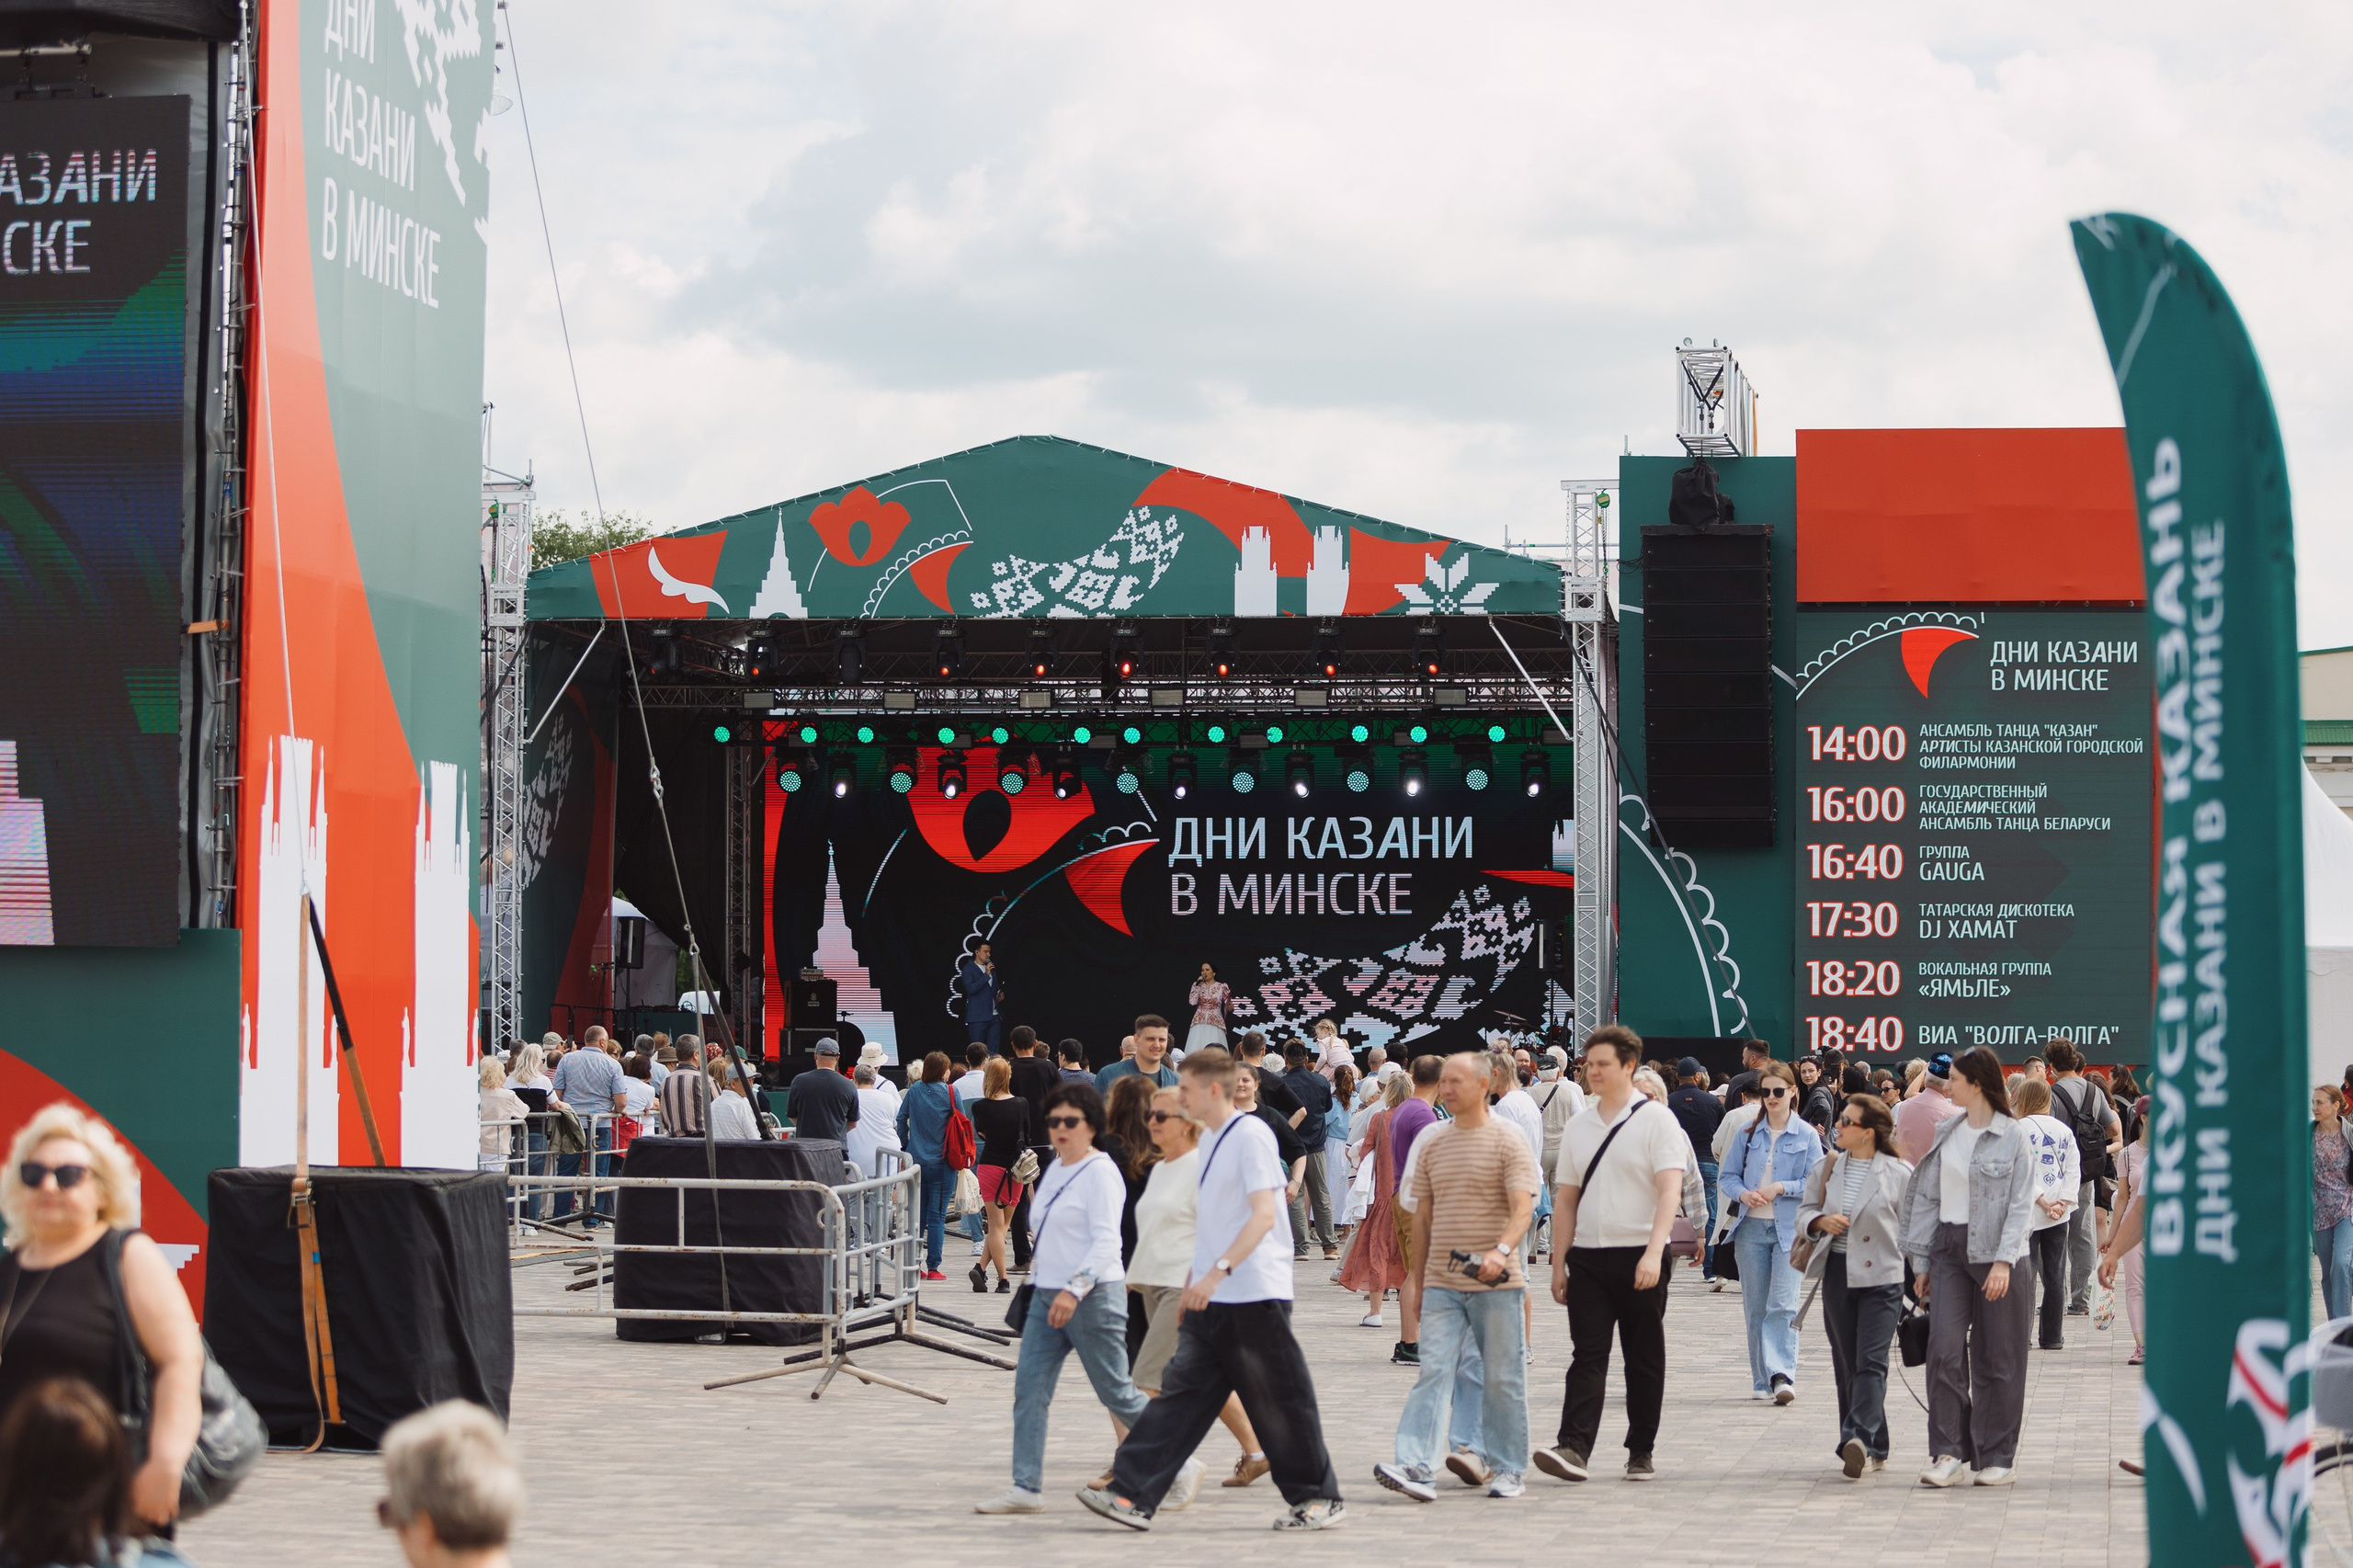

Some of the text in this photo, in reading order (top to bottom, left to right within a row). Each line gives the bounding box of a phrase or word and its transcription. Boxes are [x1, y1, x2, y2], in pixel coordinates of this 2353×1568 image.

[324, 0, 374, 63] ДНИ
[325, 67, 415, 192] КАЗАНИ
[322, 176, 440, 309] В МИНСКЕ
[1990, 641, 2138, 666] ДНИ КАЗАНИ
[1991, 668, 2109, 691] В МИНСКЕ
[1807, 725, 1906, 761] 14:00
[1919, 723, 2098, 739] АНСАМБЛЬ ТАНЦА "КАЗАН"
[1919, 738, 2143, 756] АРТИСТЫ КАЗАНСКОЙ ГОРОДСКОЙ
[1919, 756, 2016, 769] ФИЛАРМОНИИ
[1919, 782, 2048, 799] ГОСУДАРСТВЕННЫЙ
[1807, 786, 1905, 822] 16:00
[1919, 799, 2036, 815] АКАДЕМИЧЕСКИЙ
[1919, 817, 2111, 832] АНСАМБЛЬ ТАНЦА БЕЛАРУСИ
[1169, 816, 1472, 868] ДНИ КАЗАНИ
[1919, 846, 1970, 859] ГРУППА
[2145, 436, 2192, 1256] ВКУСНАЯ КАЗАНЬ
[1807, 844, 1903, 880] 16:40
[1919, 862, 1985, 881] GAUGA
[1171, 873, 1413, 915] В МИНСКЕ
[2190, 518, 2239, 1264] ДНИ КАЗАНИ В МИНСКЕ
[1806, 902, 1899, 937] 17:30
[1919, 903, 2075, 918] ТАТАРСКАЯ ДИСКОТЕКА
[1919, 920, 2018, 938] DJ ХАМАТ
[1806, 960, 1901, 995] 18:20
[1919, 962, 2052, 976] ВОКАЛЬНАЯ ГРУППА
[1918, 979, 2011, 998] «ЯМЬЛЕ»
[1806, 1016, 1904, 1051] 18:40
[1918, 1026, 1958, 1044] ВИА
